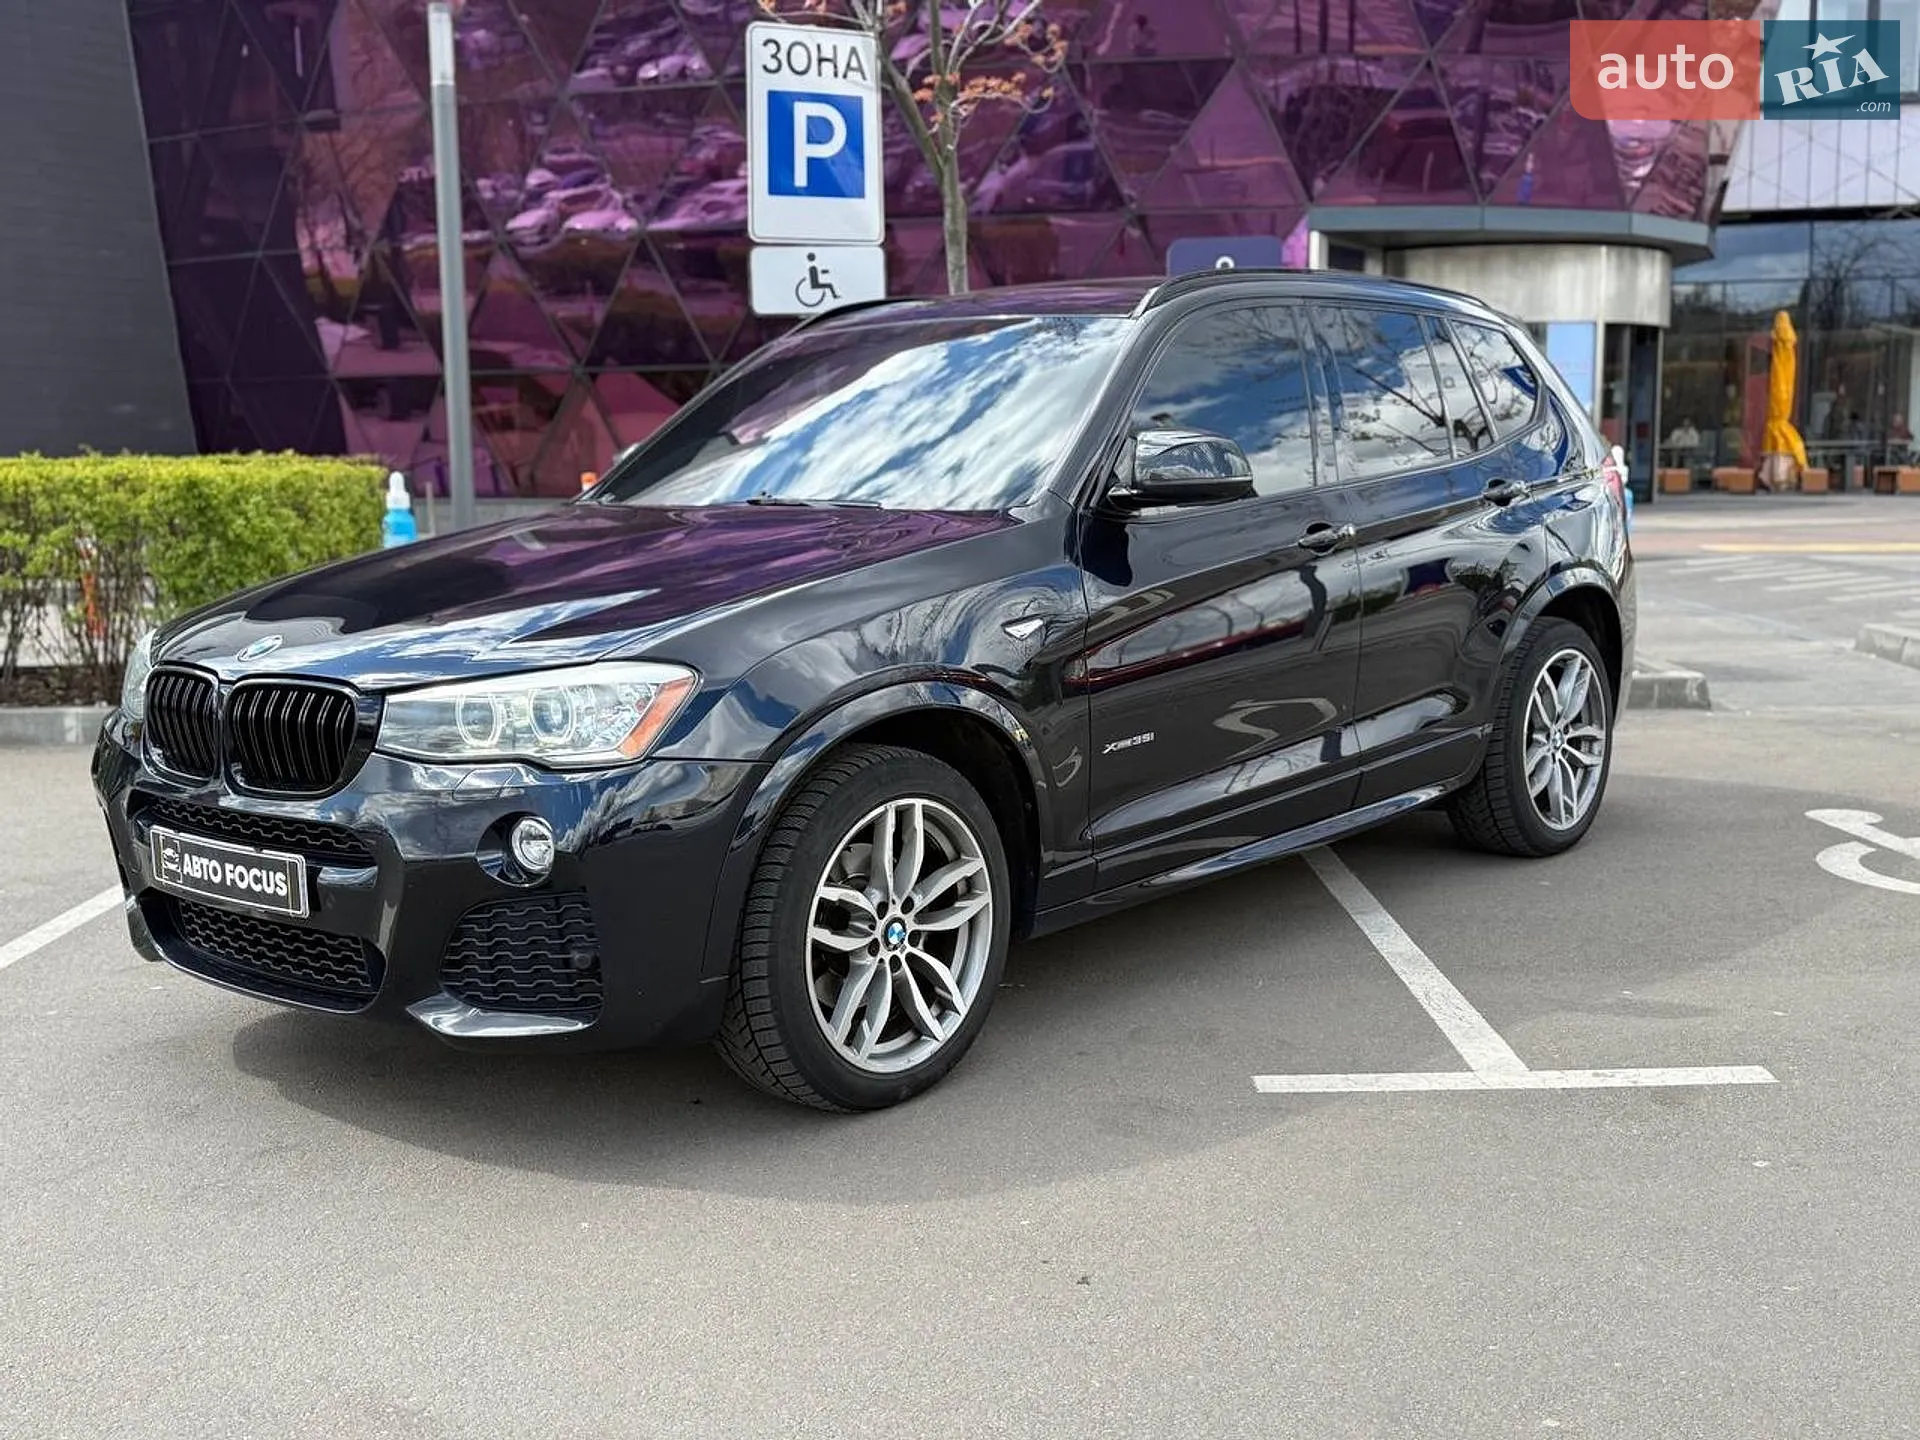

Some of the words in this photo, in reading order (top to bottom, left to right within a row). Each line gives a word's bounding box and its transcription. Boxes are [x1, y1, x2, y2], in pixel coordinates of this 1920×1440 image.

[762, 38, 867, 81] ЗОНА
[794, 101, 847, 188] P
[225, 862, 288, 897] FOCUS
